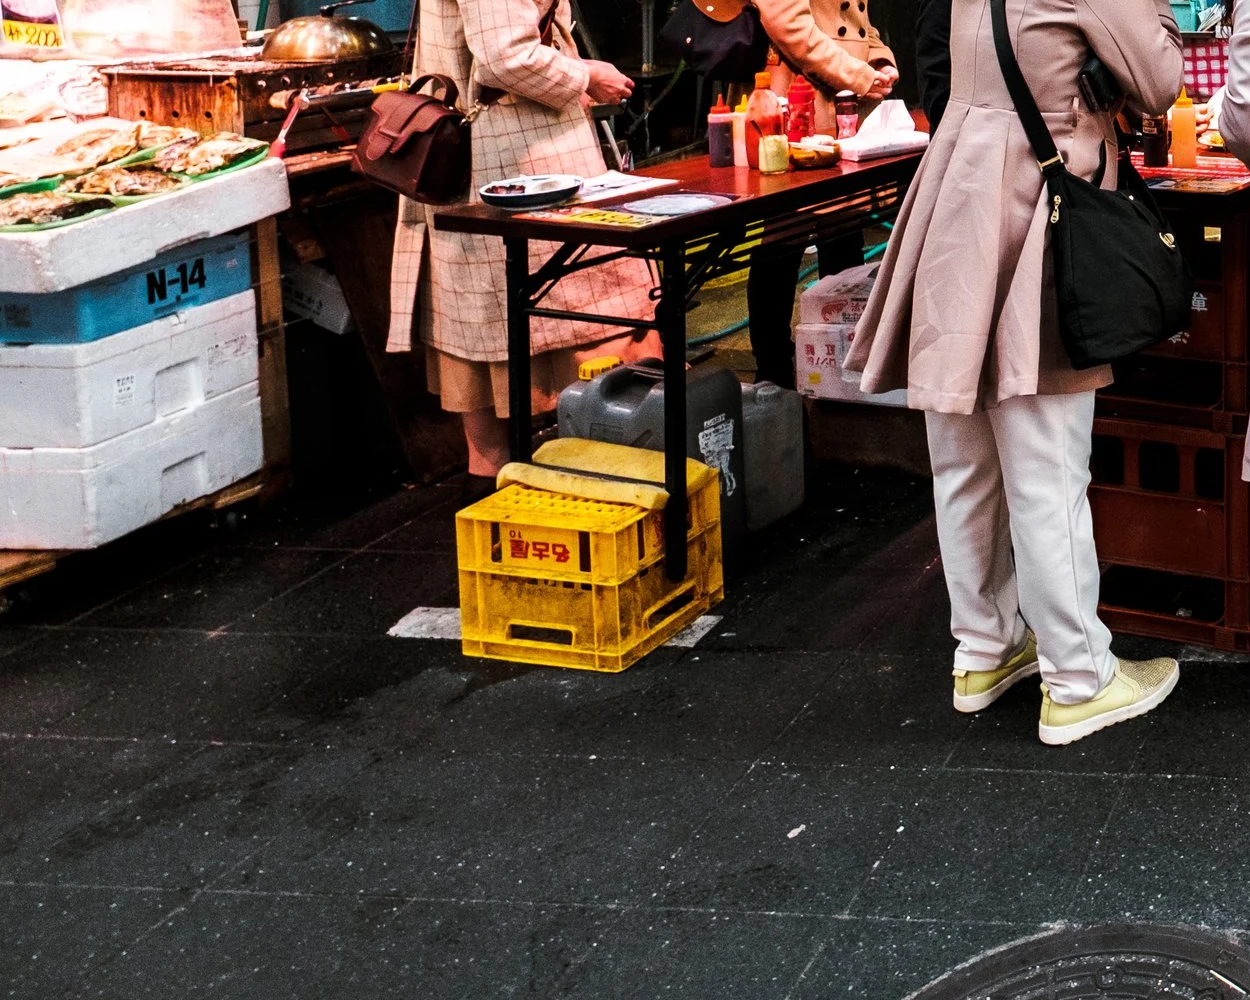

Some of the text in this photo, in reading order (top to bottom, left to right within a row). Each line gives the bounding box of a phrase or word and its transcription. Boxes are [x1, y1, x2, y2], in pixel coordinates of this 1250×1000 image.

[146, 258, 207, 304] N-14
[509, 538, 571, 563] 名古屋
